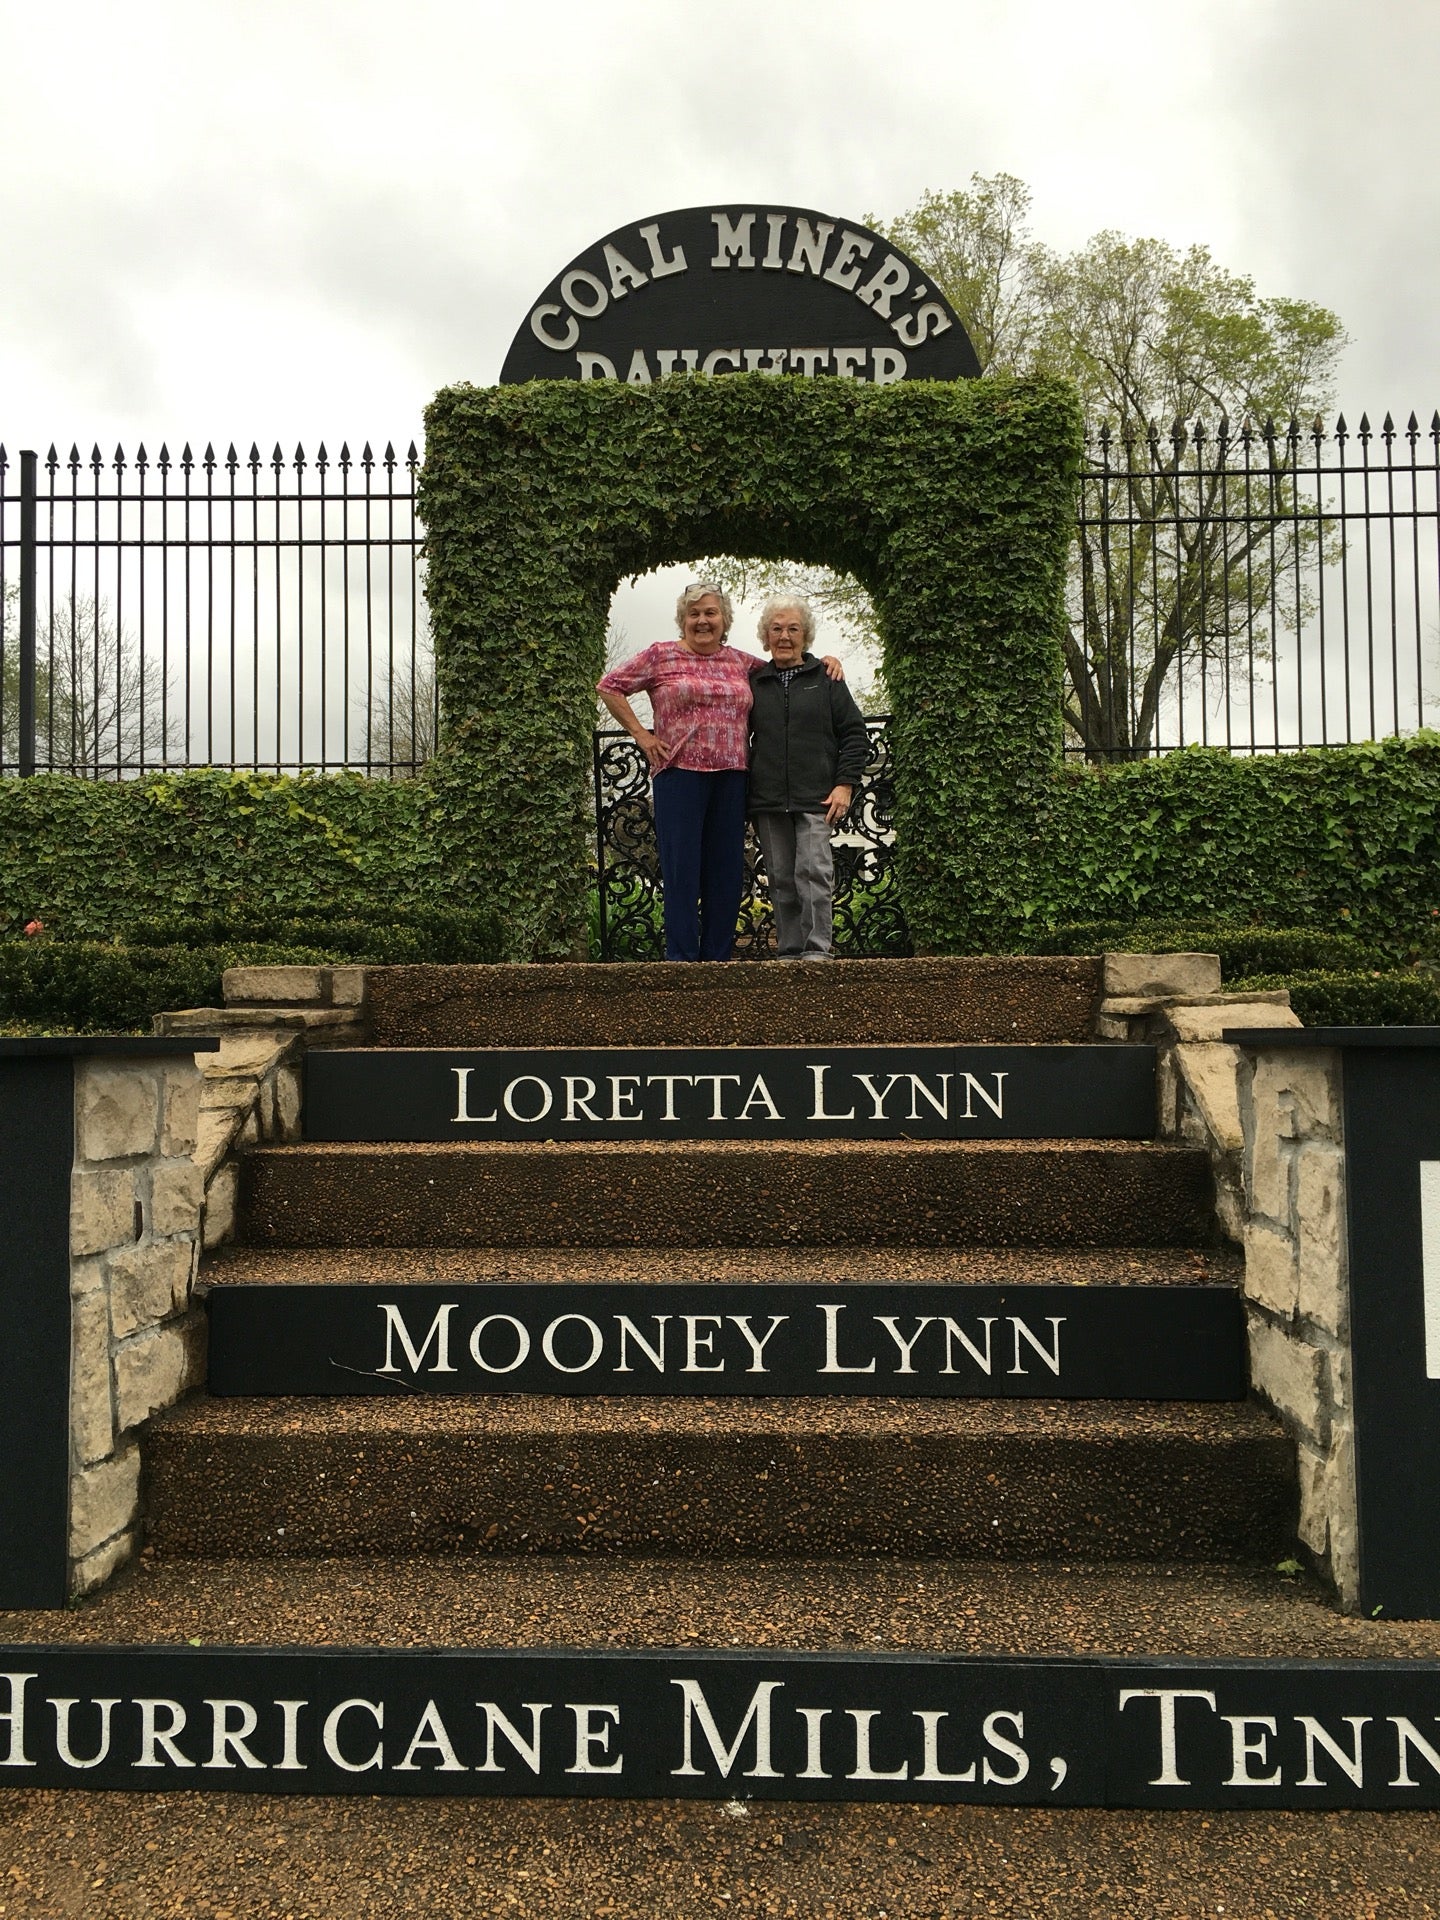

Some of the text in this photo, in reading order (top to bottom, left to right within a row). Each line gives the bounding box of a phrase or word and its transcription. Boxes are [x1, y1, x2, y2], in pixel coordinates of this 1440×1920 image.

[530, 213, 952, 350] COAL MINER'S
[576, 347, 907, 386] DAUGHTER
[451, 1065, 1008, 1124] LORETTA LYNN
[376, 1303, 1066, 1376] MOONEY LYNN
[670, 1679, 1068, 1791] MILLS,
